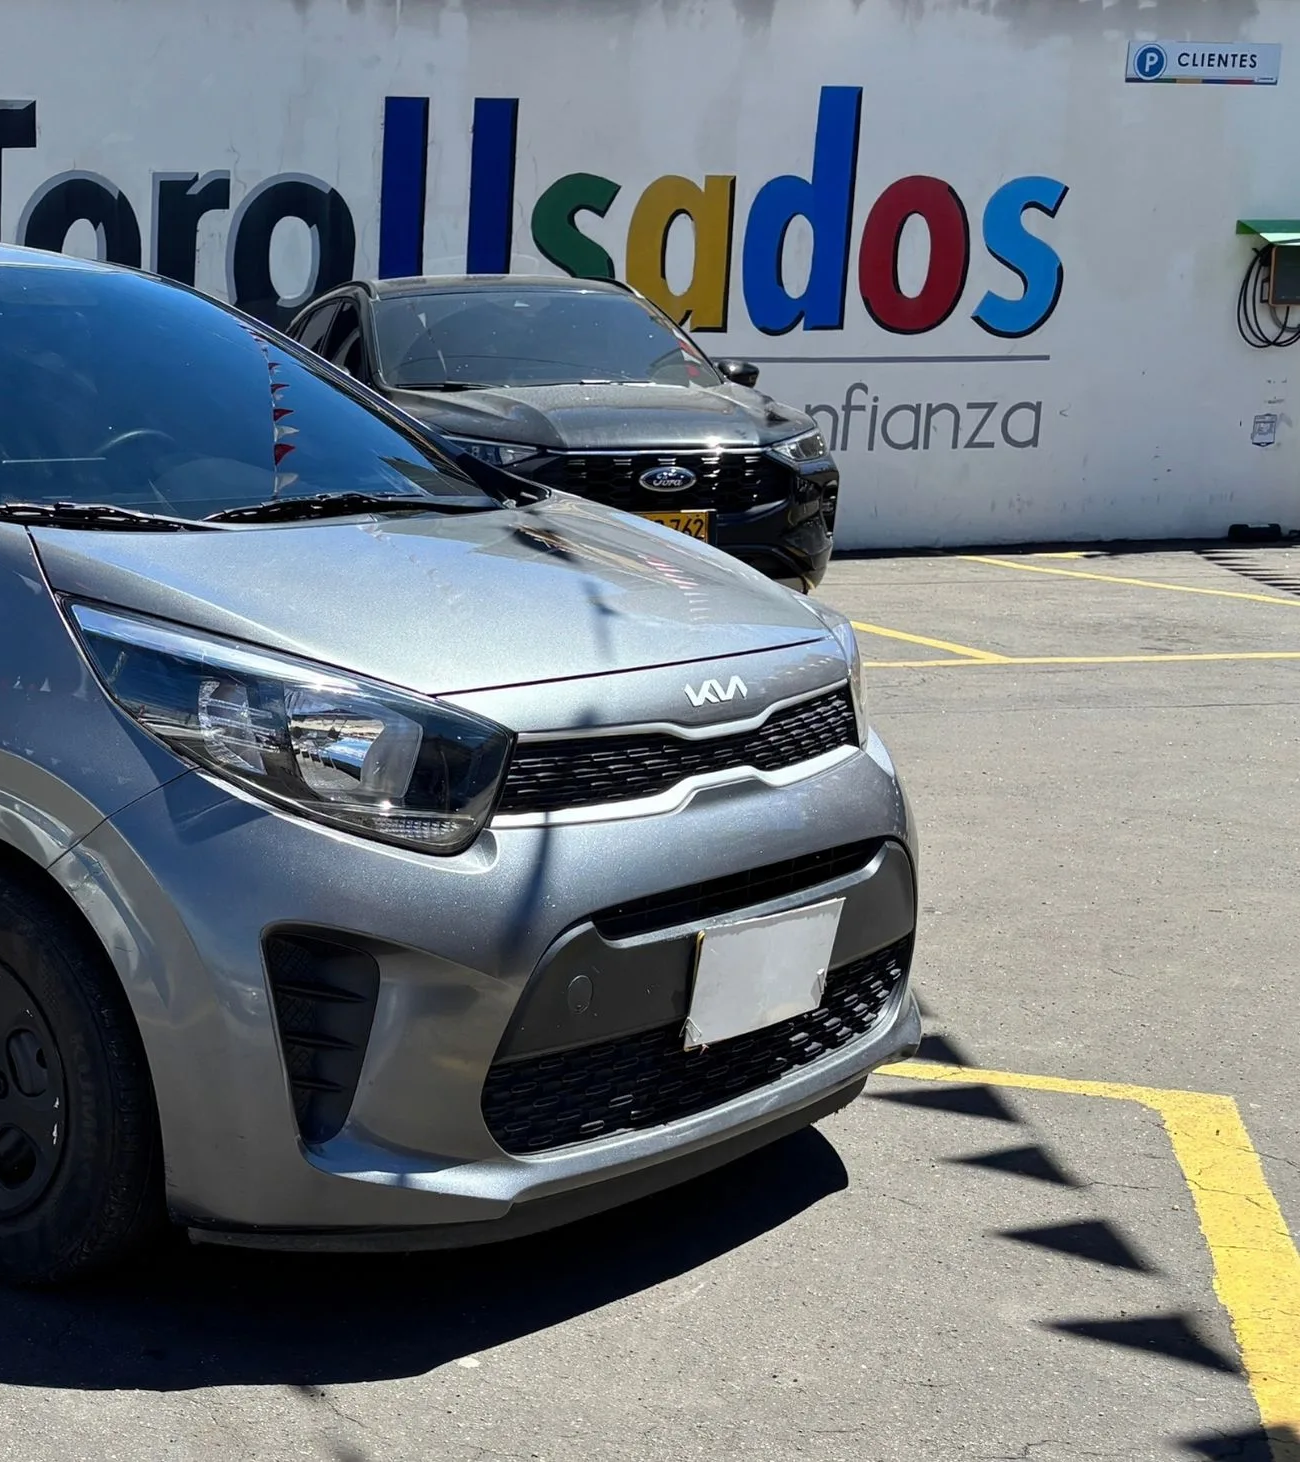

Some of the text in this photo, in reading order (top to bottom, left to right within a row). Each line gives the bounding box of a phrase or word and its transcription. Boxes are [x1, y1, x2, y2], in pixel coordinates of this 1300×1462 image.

[1177, 52, 1258, 69] CLIENTES
[652, 471, 684, 487] Ford
[684, 675, 748, 707] KIA
